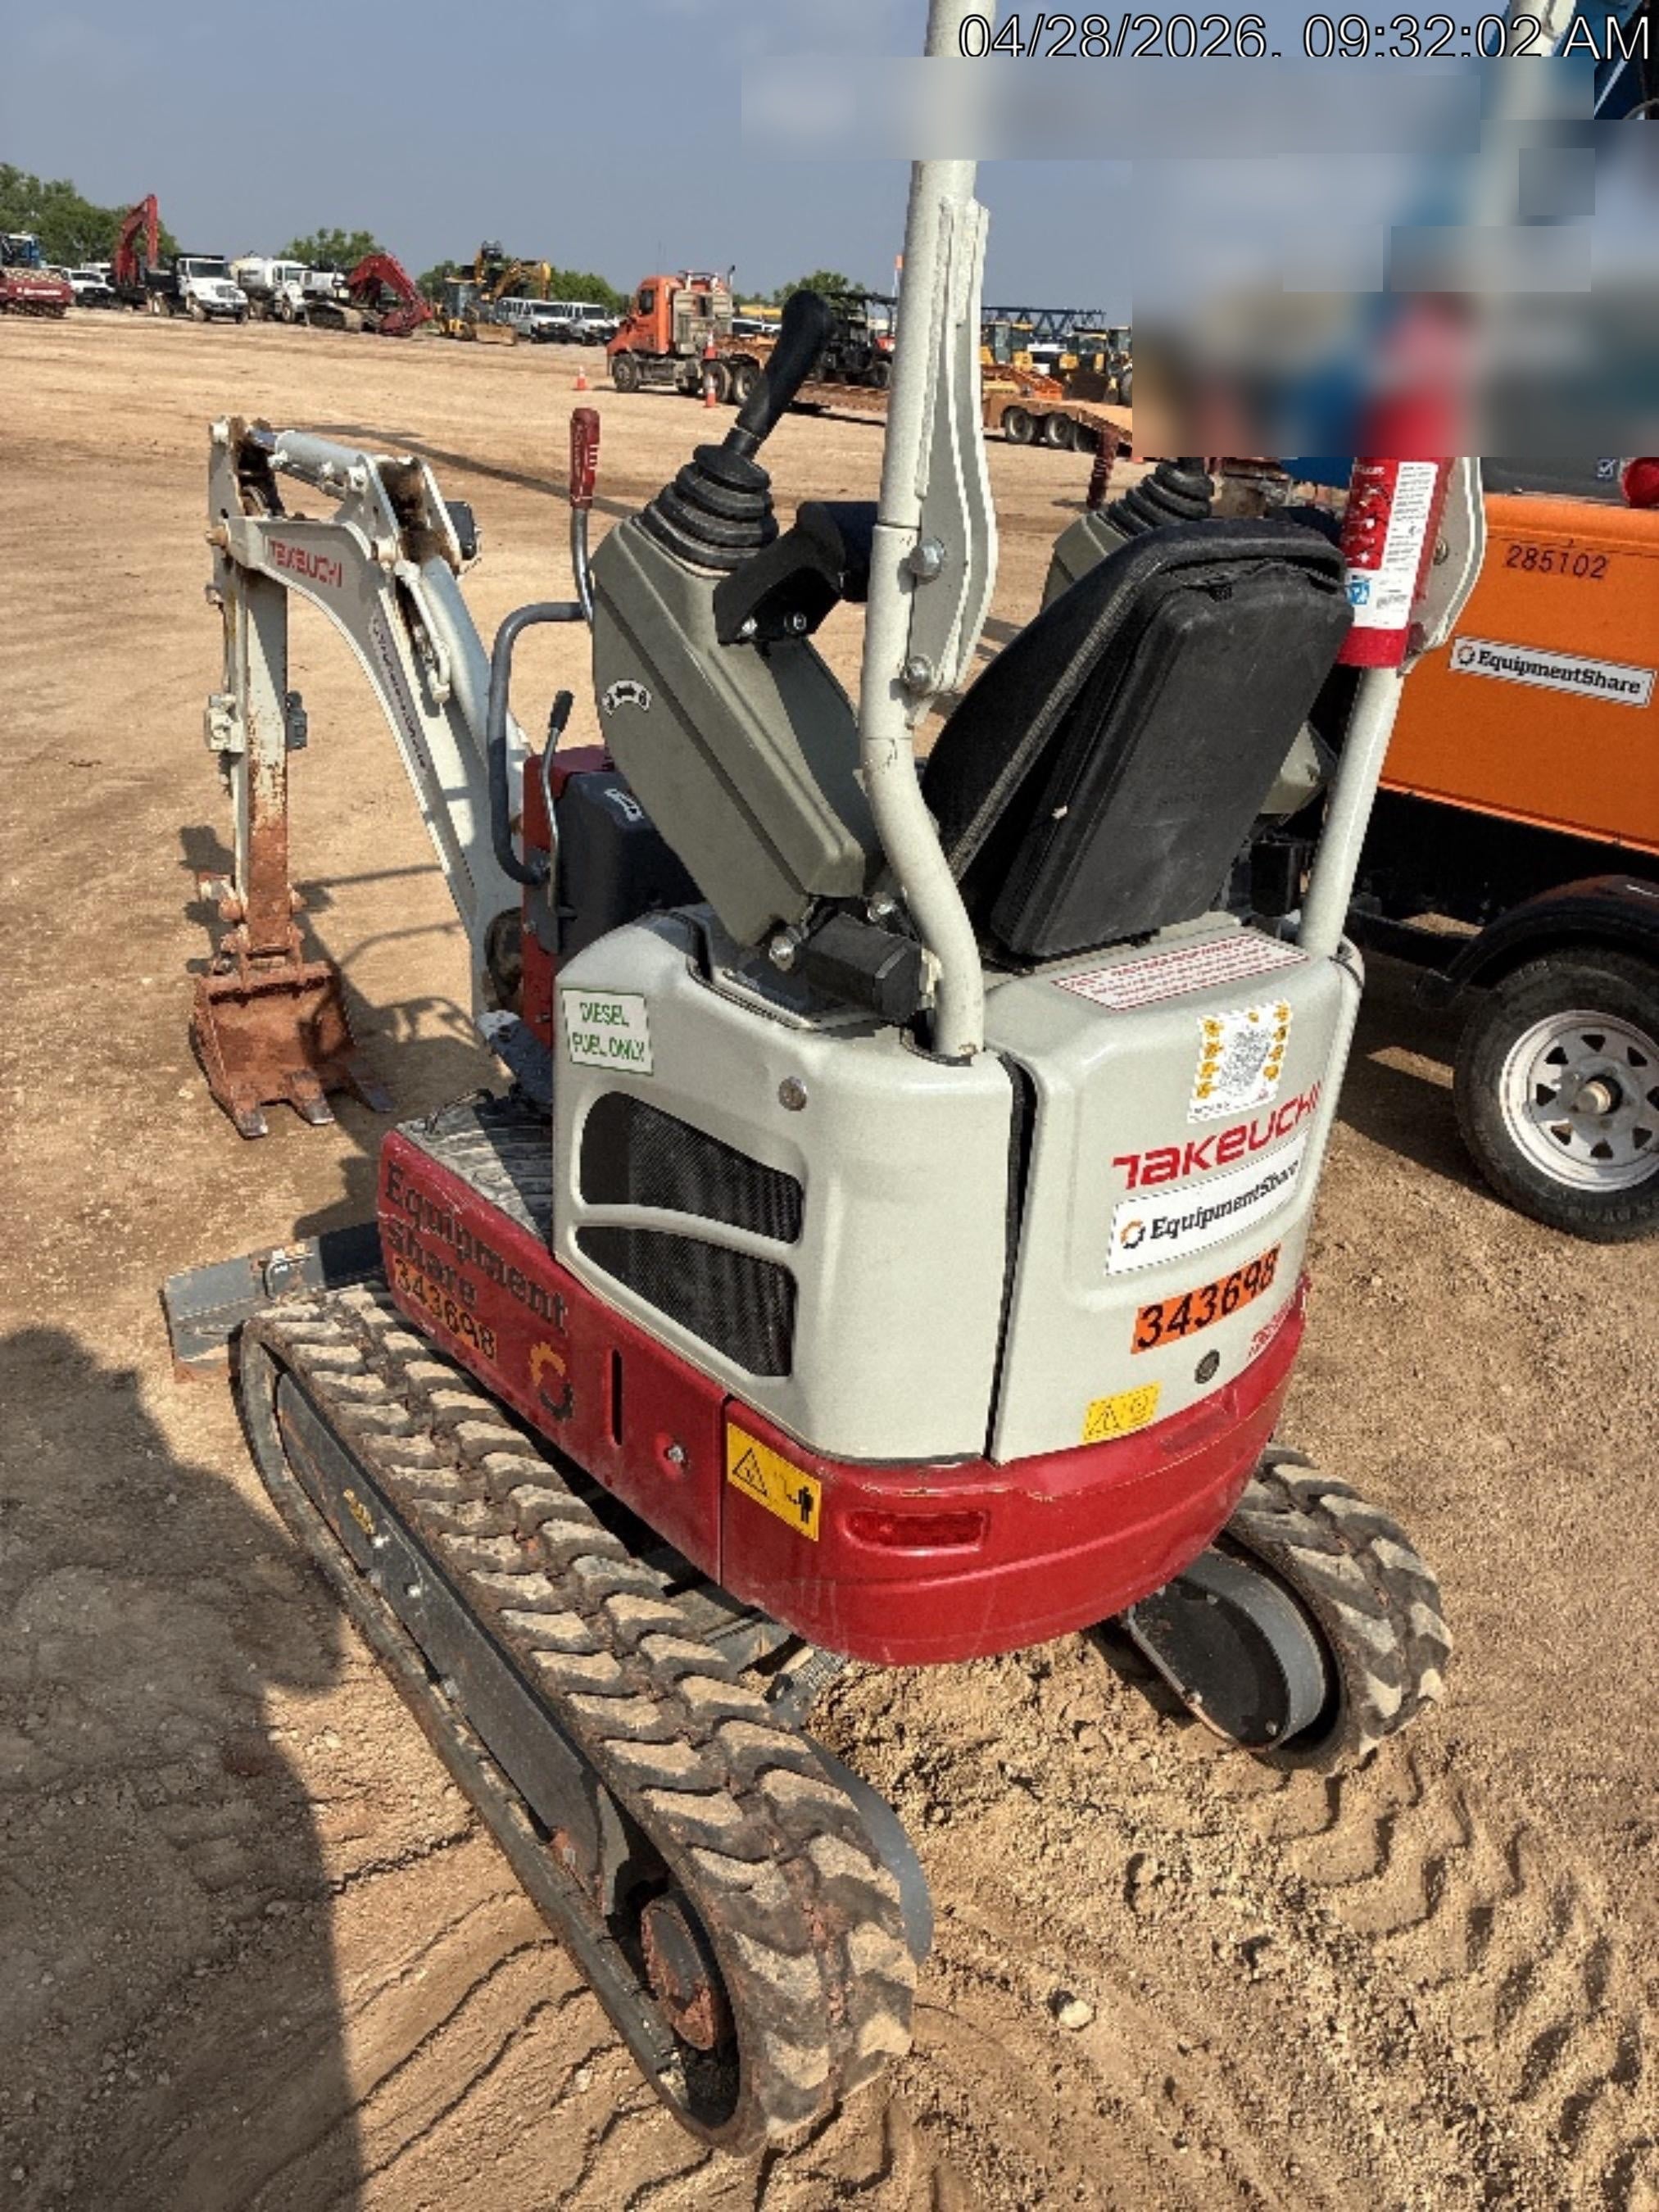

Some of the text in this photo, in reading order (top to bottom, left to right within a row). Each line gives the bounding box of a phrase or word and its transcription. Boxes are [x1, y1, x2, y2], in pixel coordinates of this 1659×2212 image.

[1506, 544, 1607, 579] 285102
[1477, 650, 1641, 694] EquipmentShare
[579, 1002, 629, 1027] DIESEL
[609, 1036, 645, 1063] ONLY
[1112, 1079, 1321, 1189] TAKEUCHI
[386, 1158, 568, 1337] Equipment
[394, 1257, 495, 1361] 343698
[1137, 1246, 1280, 1349] 343698
